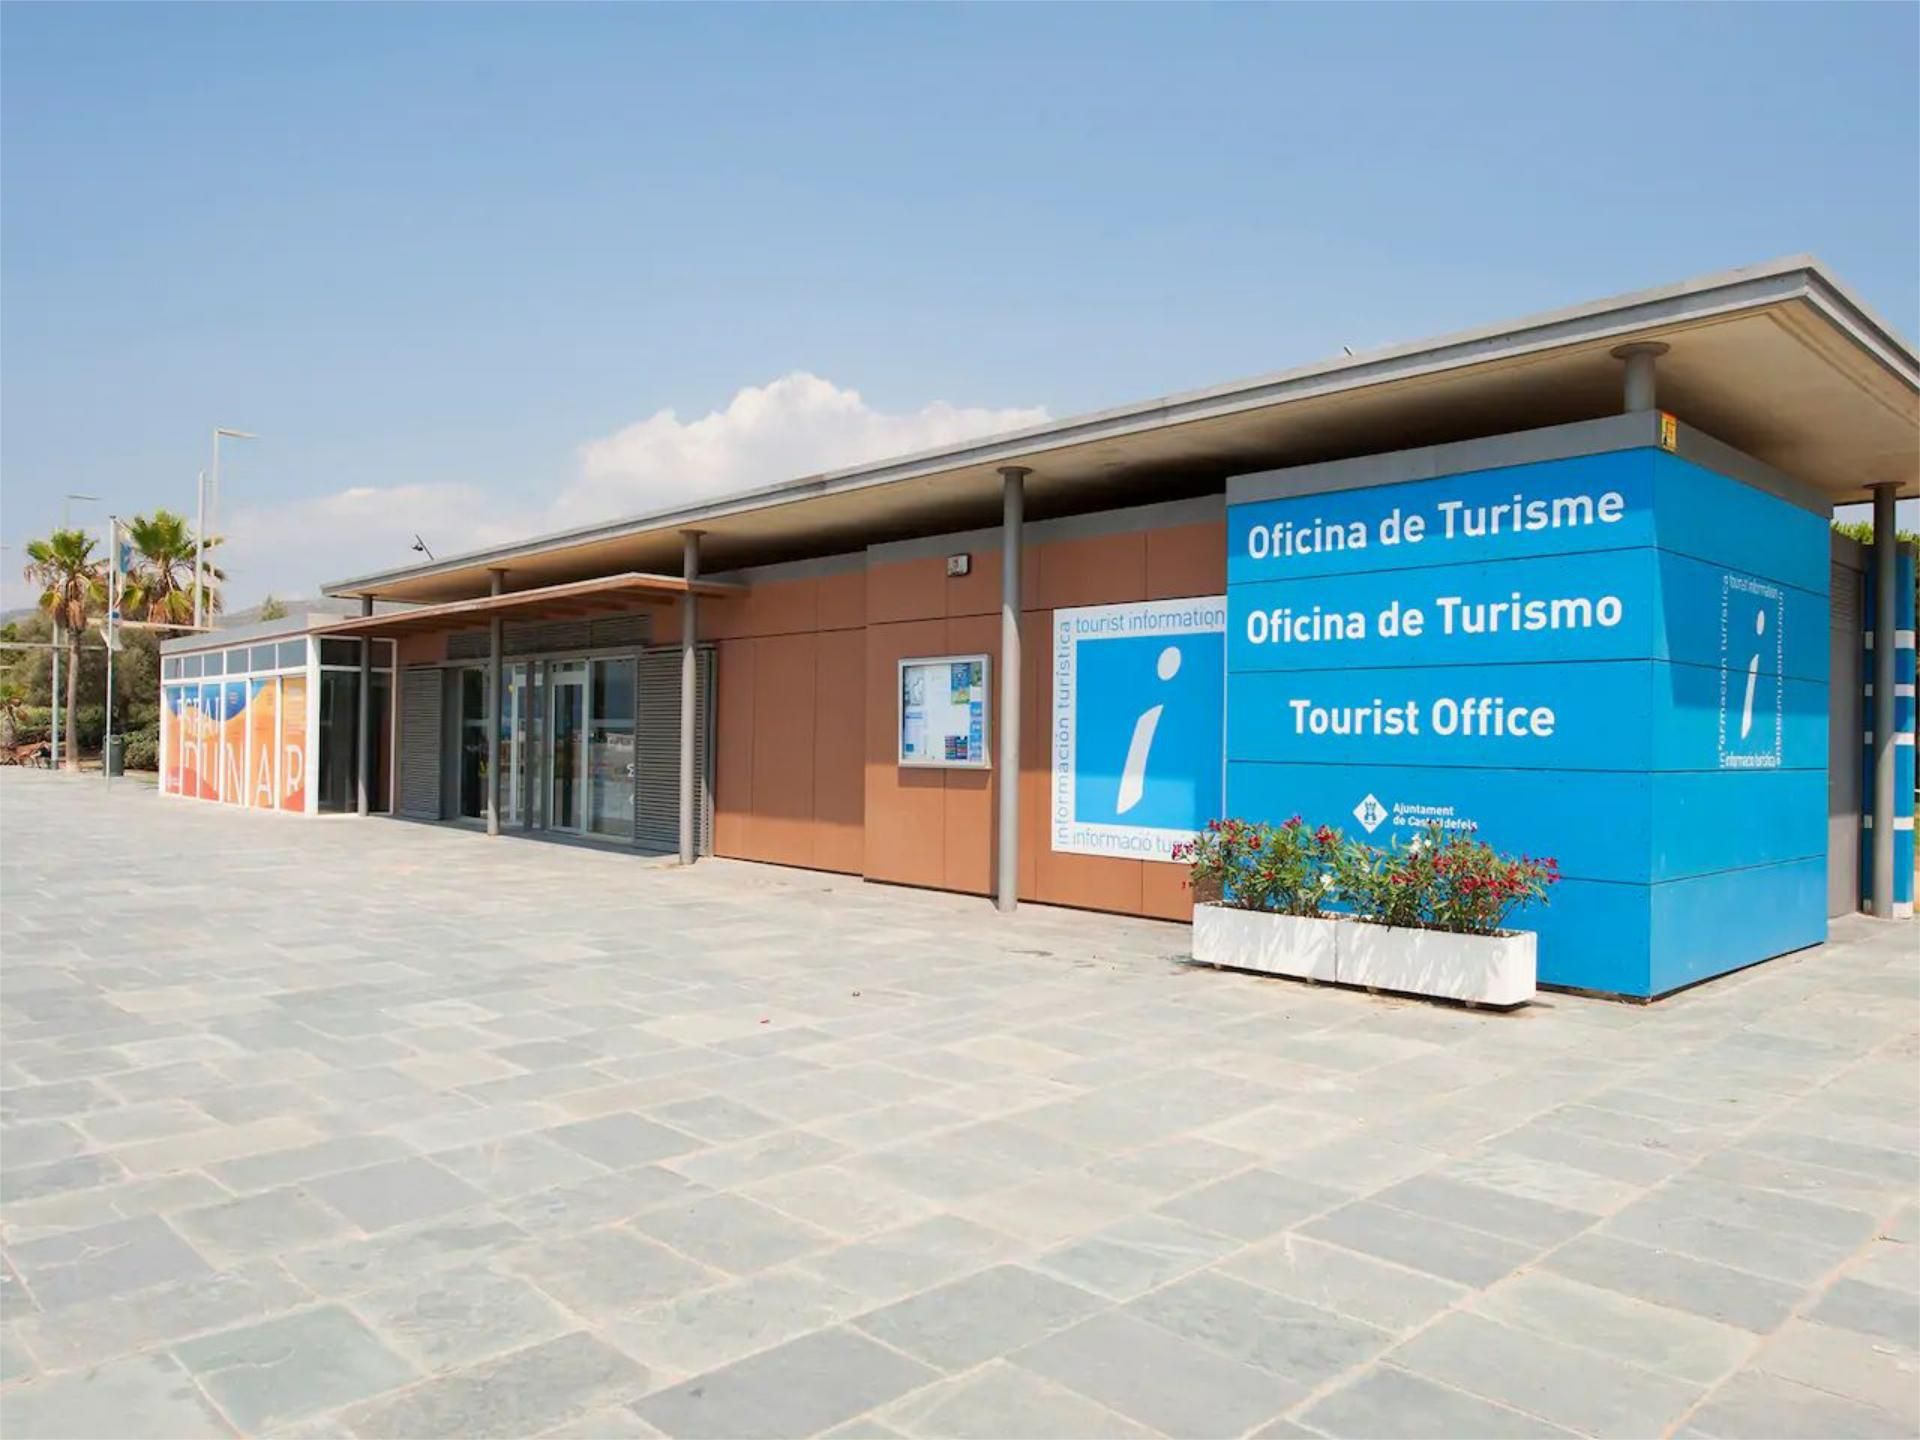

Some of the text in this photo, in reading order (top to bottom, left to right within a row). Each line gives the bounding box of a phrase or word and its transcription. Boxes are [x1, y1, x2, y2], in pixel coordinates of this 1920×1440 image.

[1248, 491, 1625, 559] Oficina de Turisme
[1076, 609, 1224, 633] tourist information
[1247, 592, 1622, 644] Oficina de Turismo
[1289, 697, 1556, 736] Tourist Office
[1055, 621, 1071, 844] información turística
[1393, 803, 1455, 816] Ajuntament
[1393, 816, 1406, 826] de
[1073, 828, 1152, 851] informació
